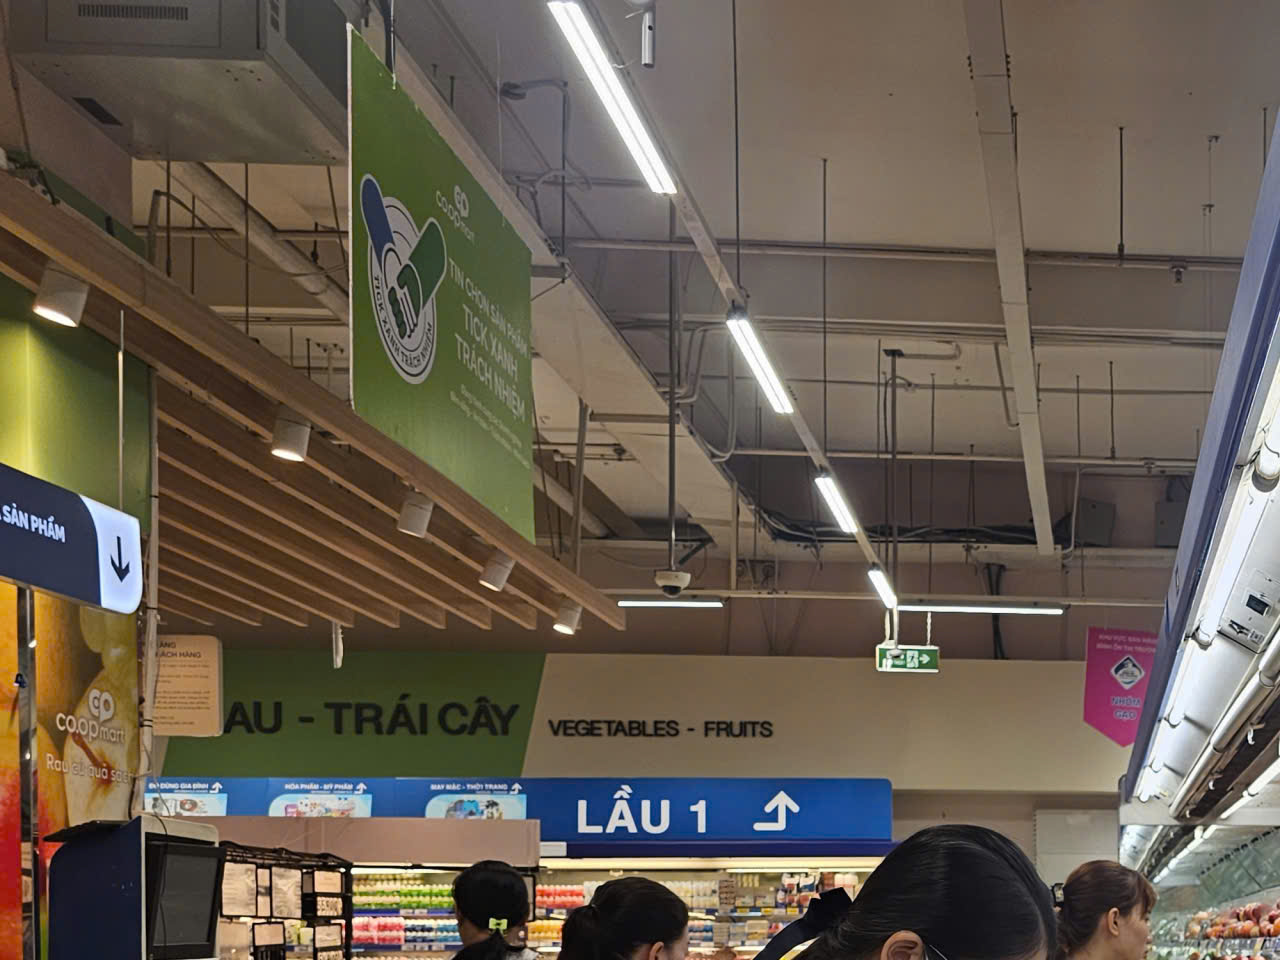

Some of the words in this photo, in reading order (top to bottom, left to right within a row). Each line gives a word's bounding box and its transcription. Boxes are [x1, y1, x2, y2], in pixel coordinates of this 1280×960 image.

[373, 275, 385, 312] TICK
[448, 257, 465, 290] TIN
[462, 303, 489, 351] TICK
[489, 332, 519, 383] XANH
[454, 332, 493, 391] TRÁCH
[494, 377, 526, 422] NHIỆM
[2, 503, 30, 531] SẢN
[30, 515, 66, 543] PHẨM
[223, 701, 282, 734] AU
[324, 692, 428, 735] TRÁI
[437, 695, 520, 736] CÂY
[548, 719, 680, 738] VEGETABLES
[703, 720, 773, 738] FRUITS
[46, 753, 69, 773] Rau
[577, 783, 671, 834] LẦU
[689, 799, 707, 834] 1
